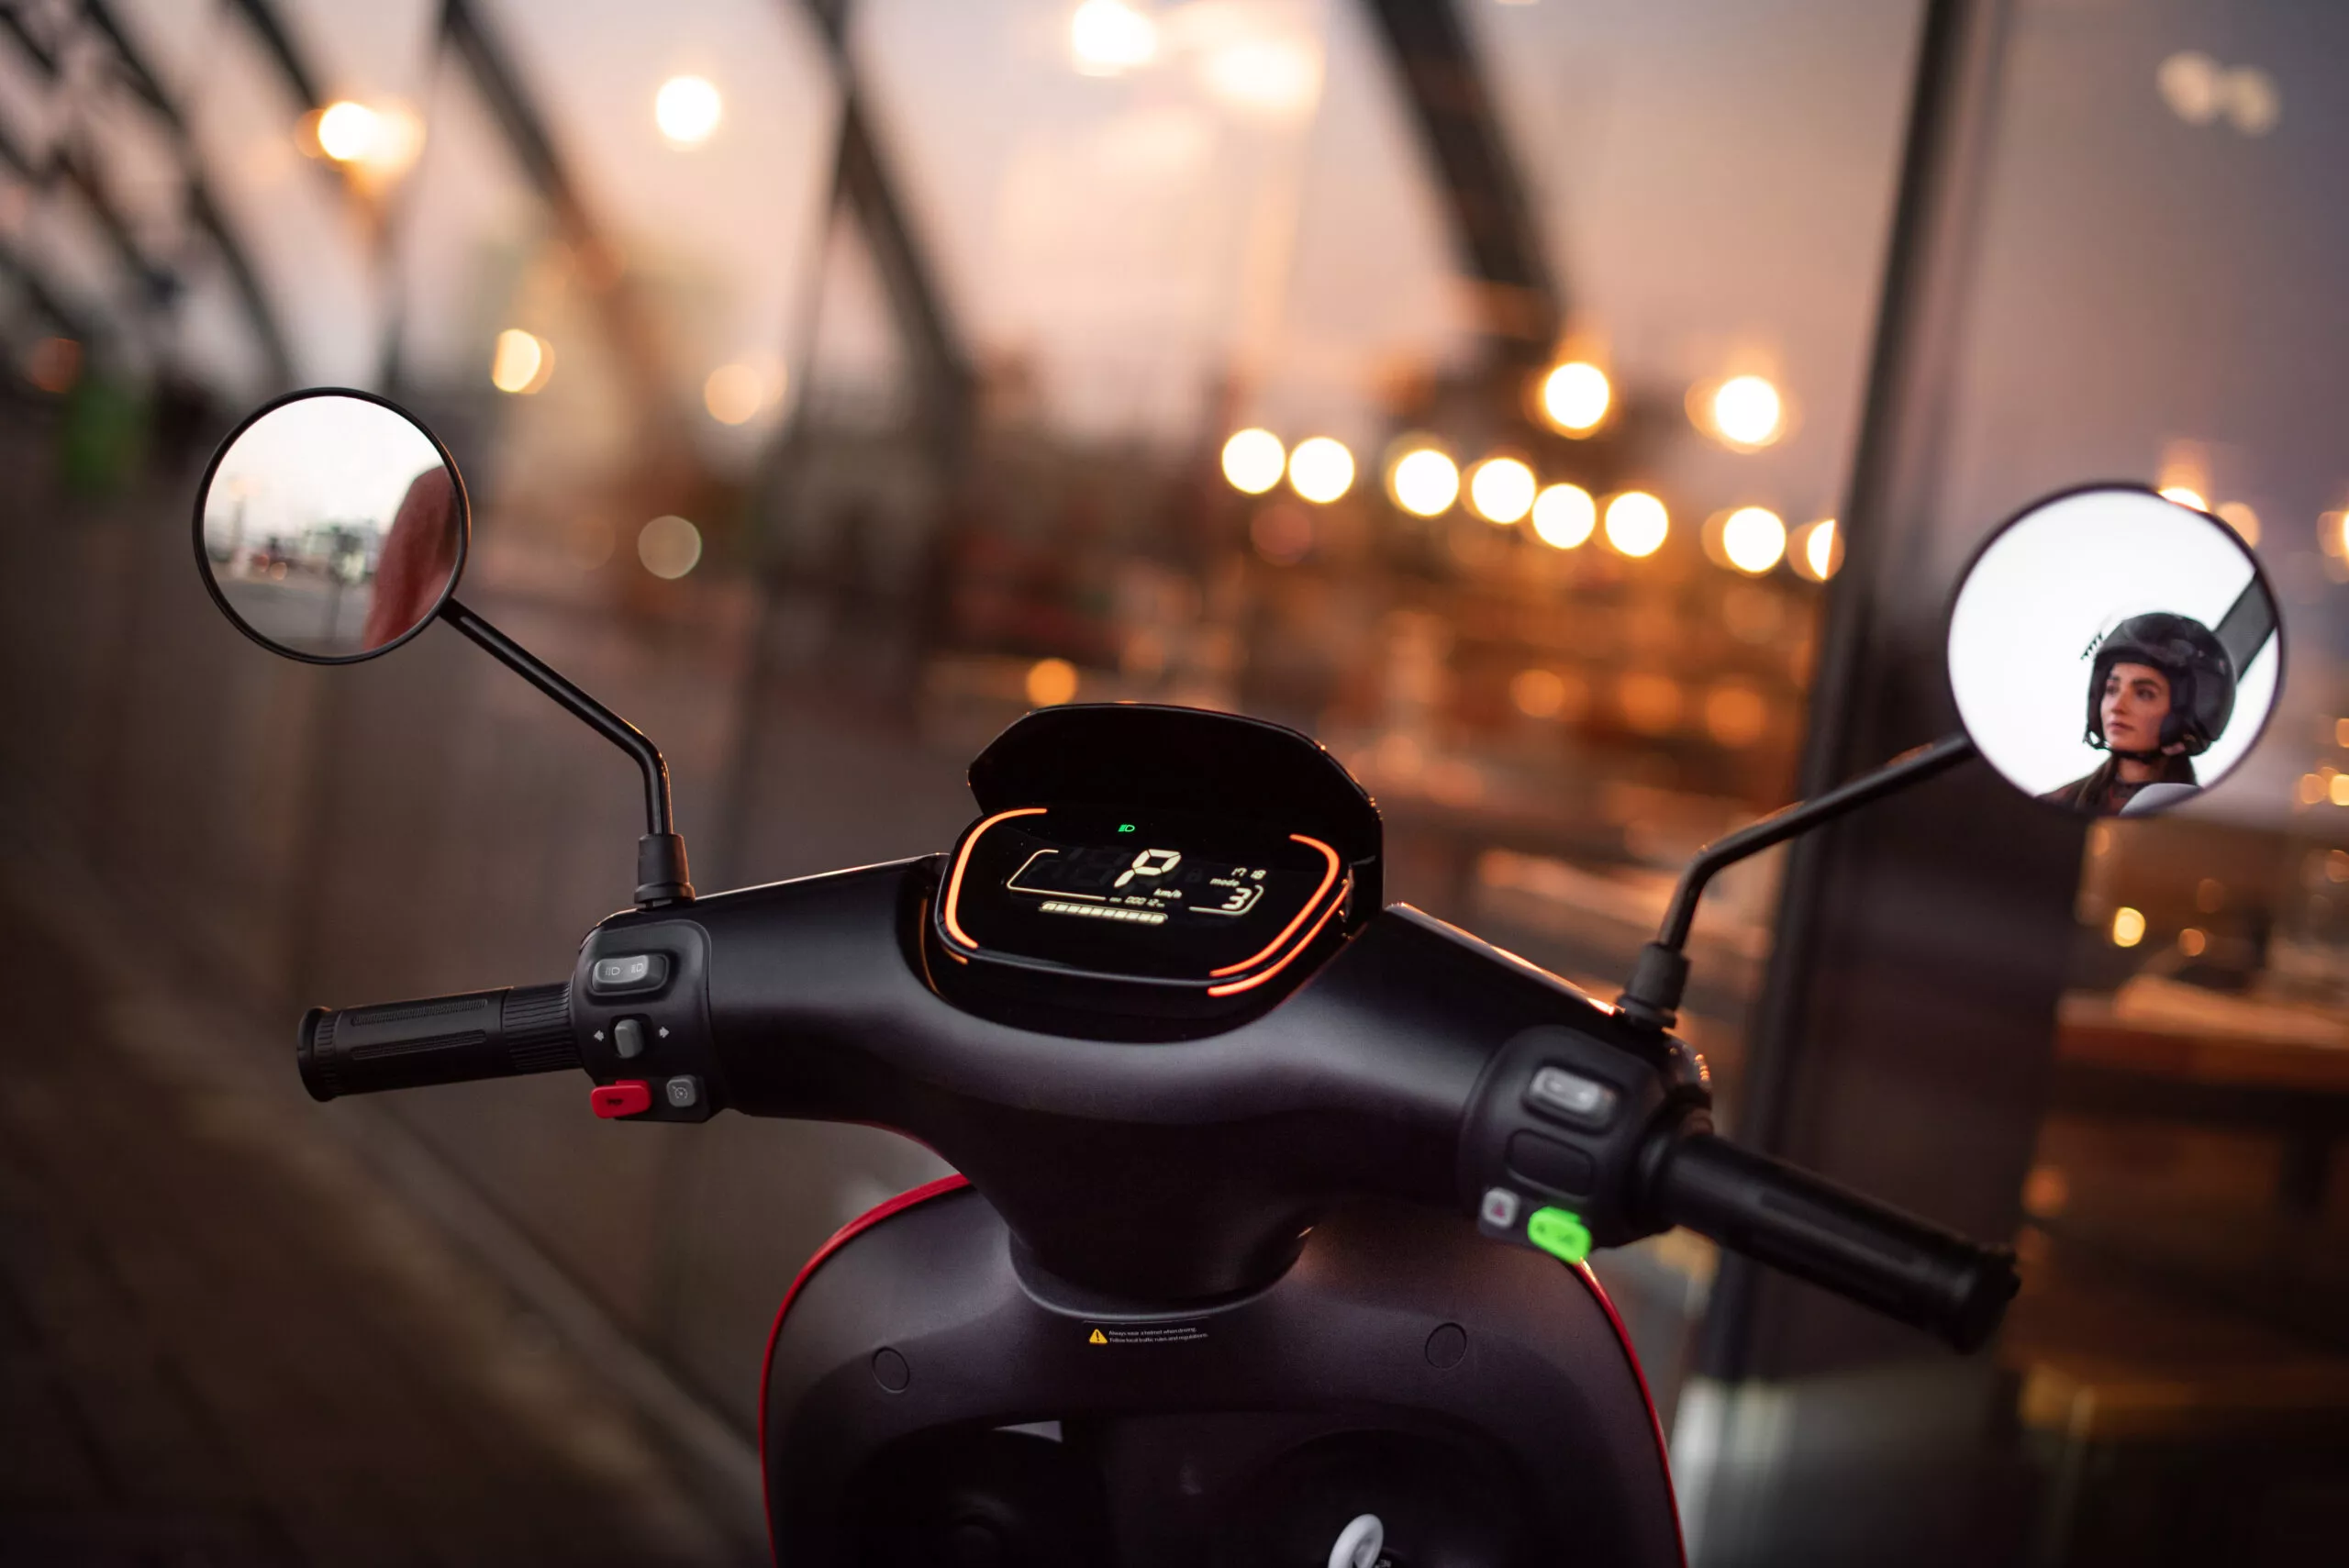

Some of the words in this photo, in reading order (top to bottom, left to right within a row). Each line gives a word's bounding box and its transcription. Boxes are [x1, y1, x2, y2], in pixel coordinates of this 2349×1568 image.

[1114, 849, 1181, 888] P
[1209, 878, 1240, 887] mode
[1153, 888, 1183, 898] km/h
[1221, 887, 1252, 910] 3
